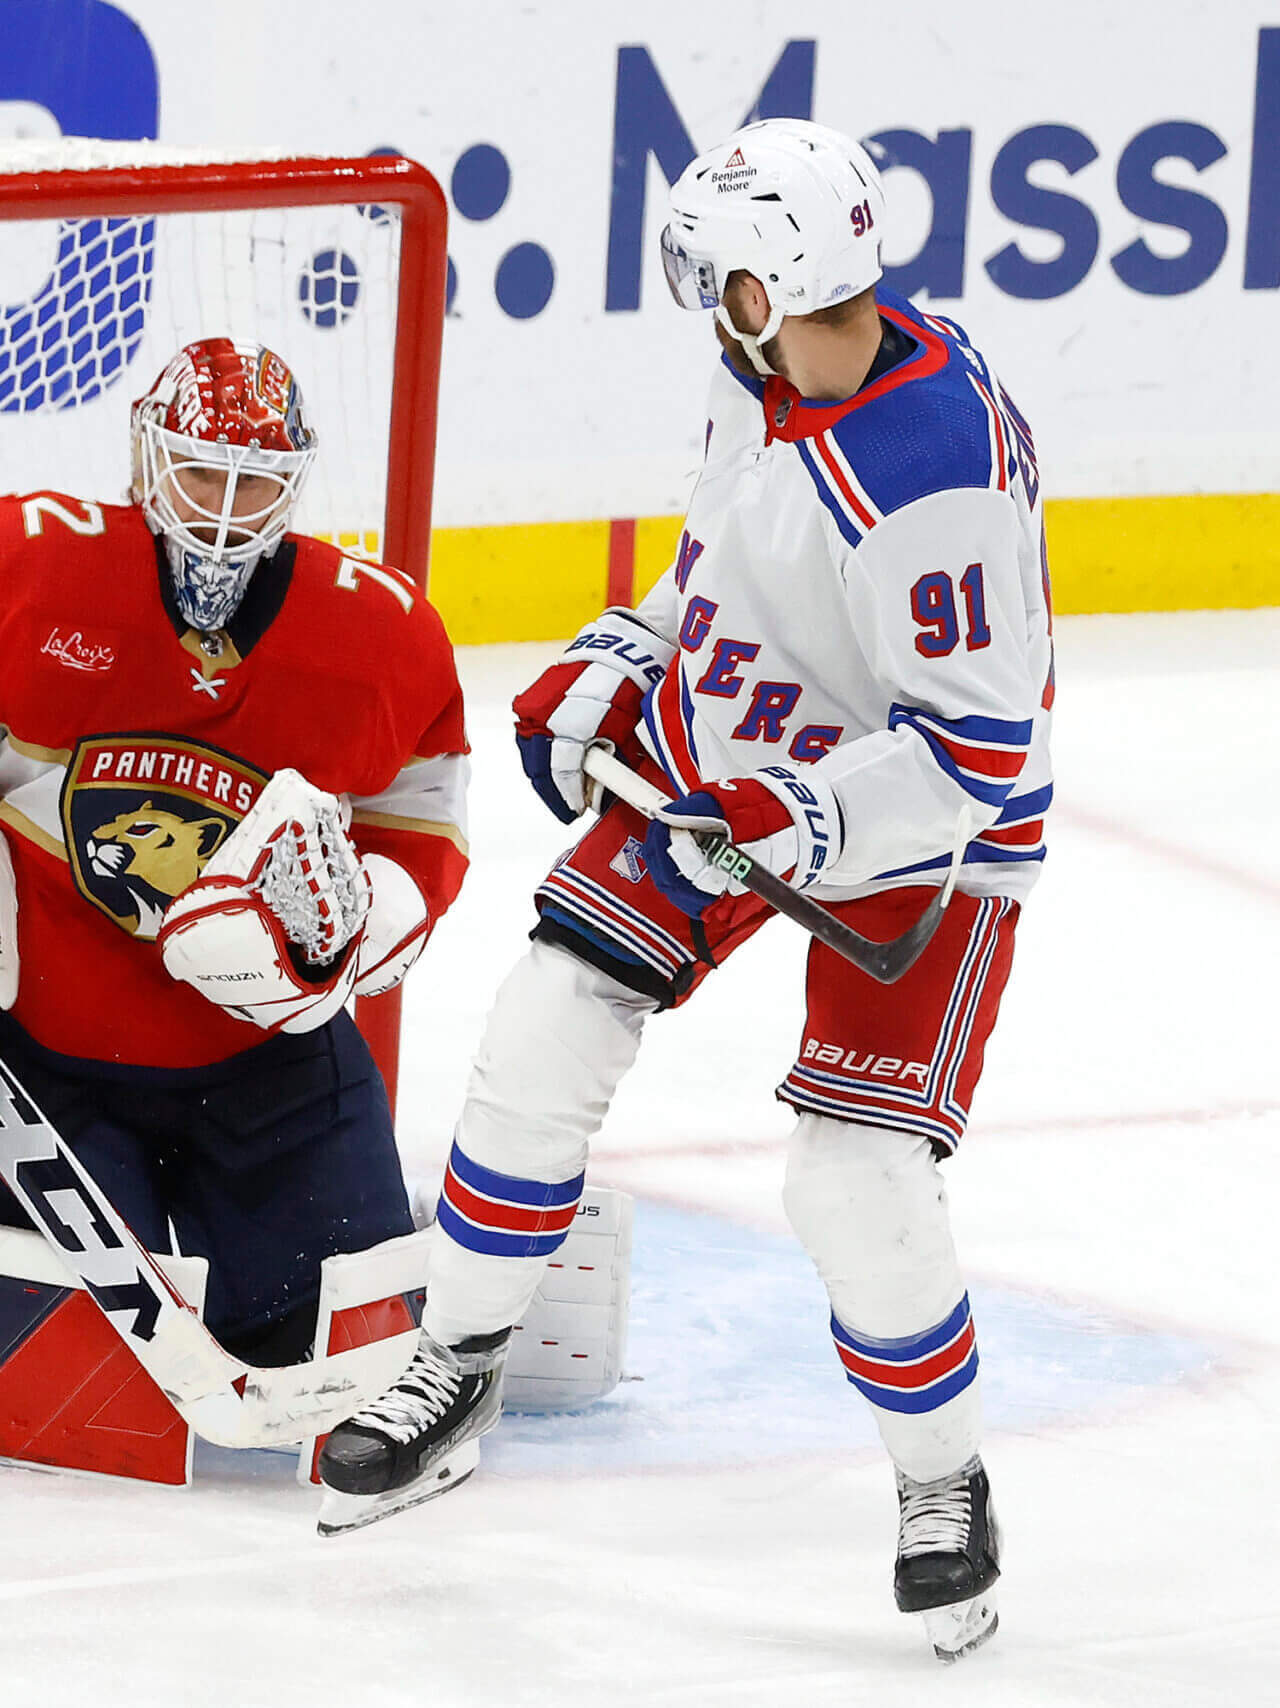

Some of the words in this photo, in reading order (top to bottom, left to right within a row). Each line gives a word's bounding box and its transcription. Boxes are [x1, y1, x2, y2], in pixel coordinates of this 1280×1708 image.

[605, 26, 1280, 312] Mass
[711, 166, 757, 183] Benjamin
[717, 181, 750, 194] Moore
[850, 198, 874, 237] 91
[910, 562, 991, 659] 91
[40, 627, 115, 671] LaCroix
[92, 752, 253, 812] PANTHERS
